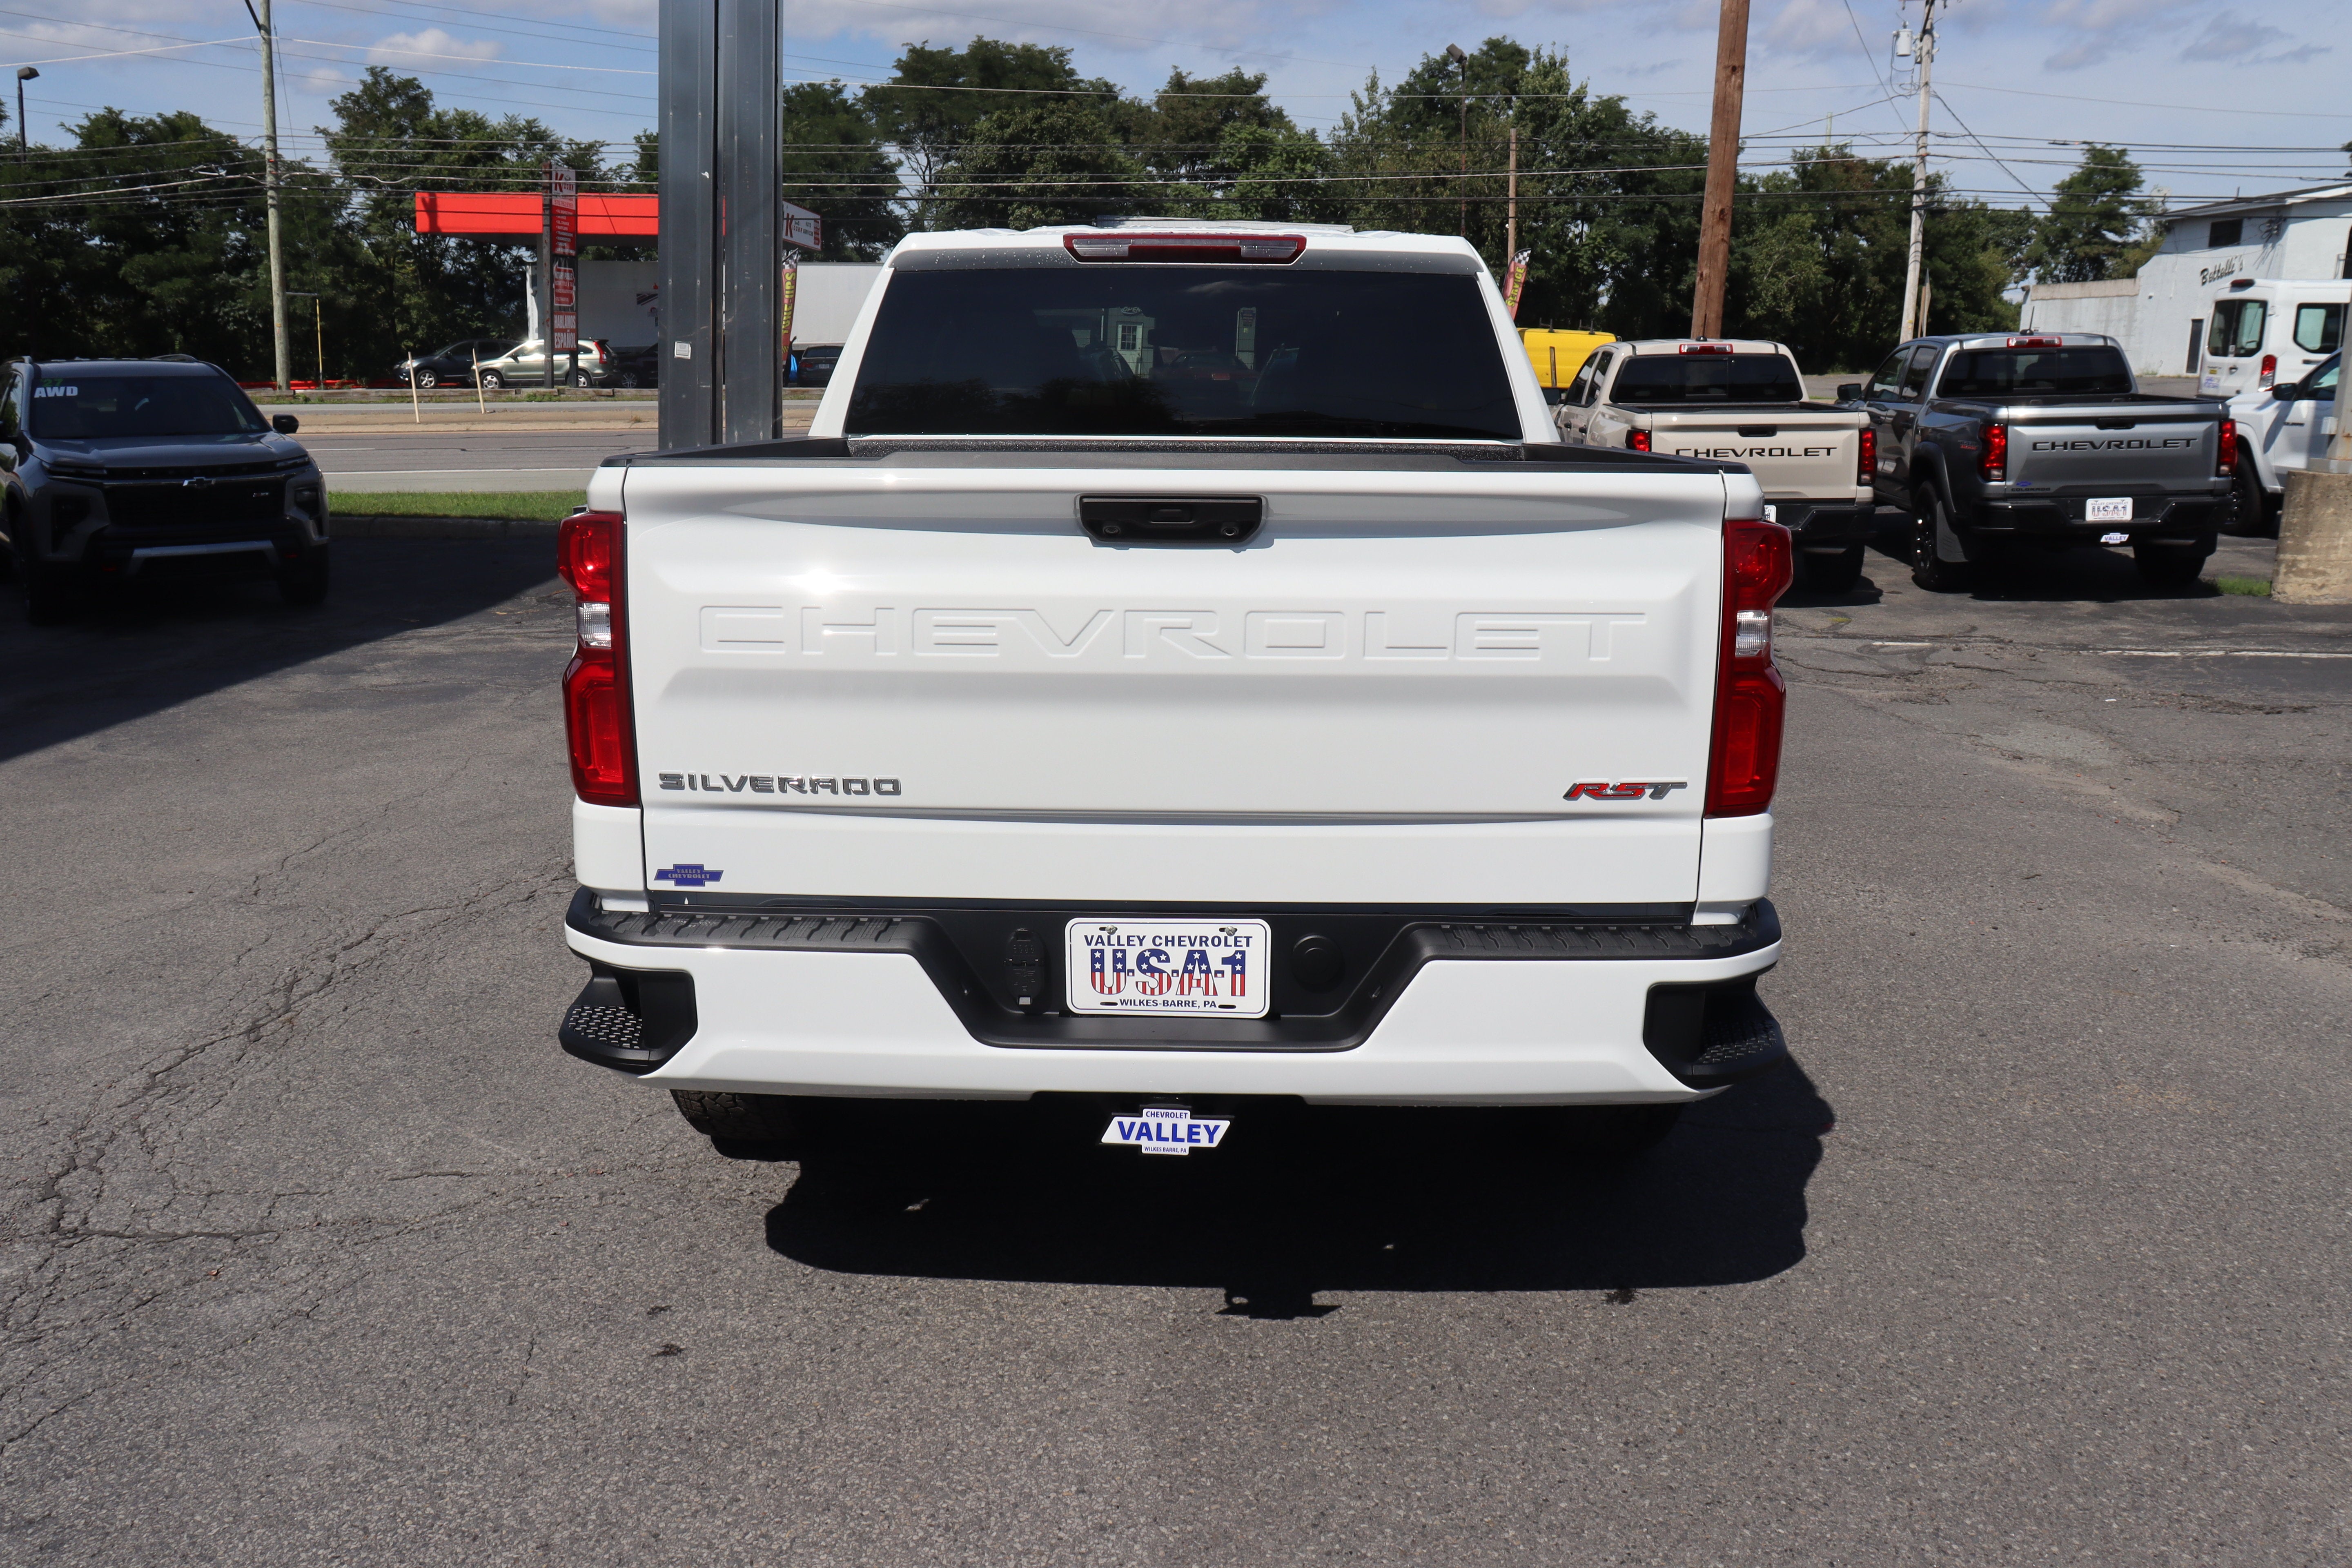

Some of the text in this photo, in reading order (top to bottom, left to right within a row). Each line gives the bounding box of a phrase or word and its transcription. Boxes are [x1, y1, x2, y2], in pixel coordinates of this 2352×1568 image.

[1507, 266, 1525, 307] SERVICE
[554, 315, 576, 329] HABLAMOS
[34, 386, 78, 398] AWD
[2033, 438, 2198, 451] CHEVROLET
[700, 606, 1646, 661] CHEVROLET
[658, 771, 902, 795] SILVERADO
[1562, 782, 1688, 801] RST
[1084, 935, 1253, 947] VALLEY CHEVROLET
[1119, 999, 1201, 1009] WILKES-BARRE,
[1145, 1111, 1188, 1119] CHEVROLET
[1117, 1121, 1221, 1144] VALLEY
